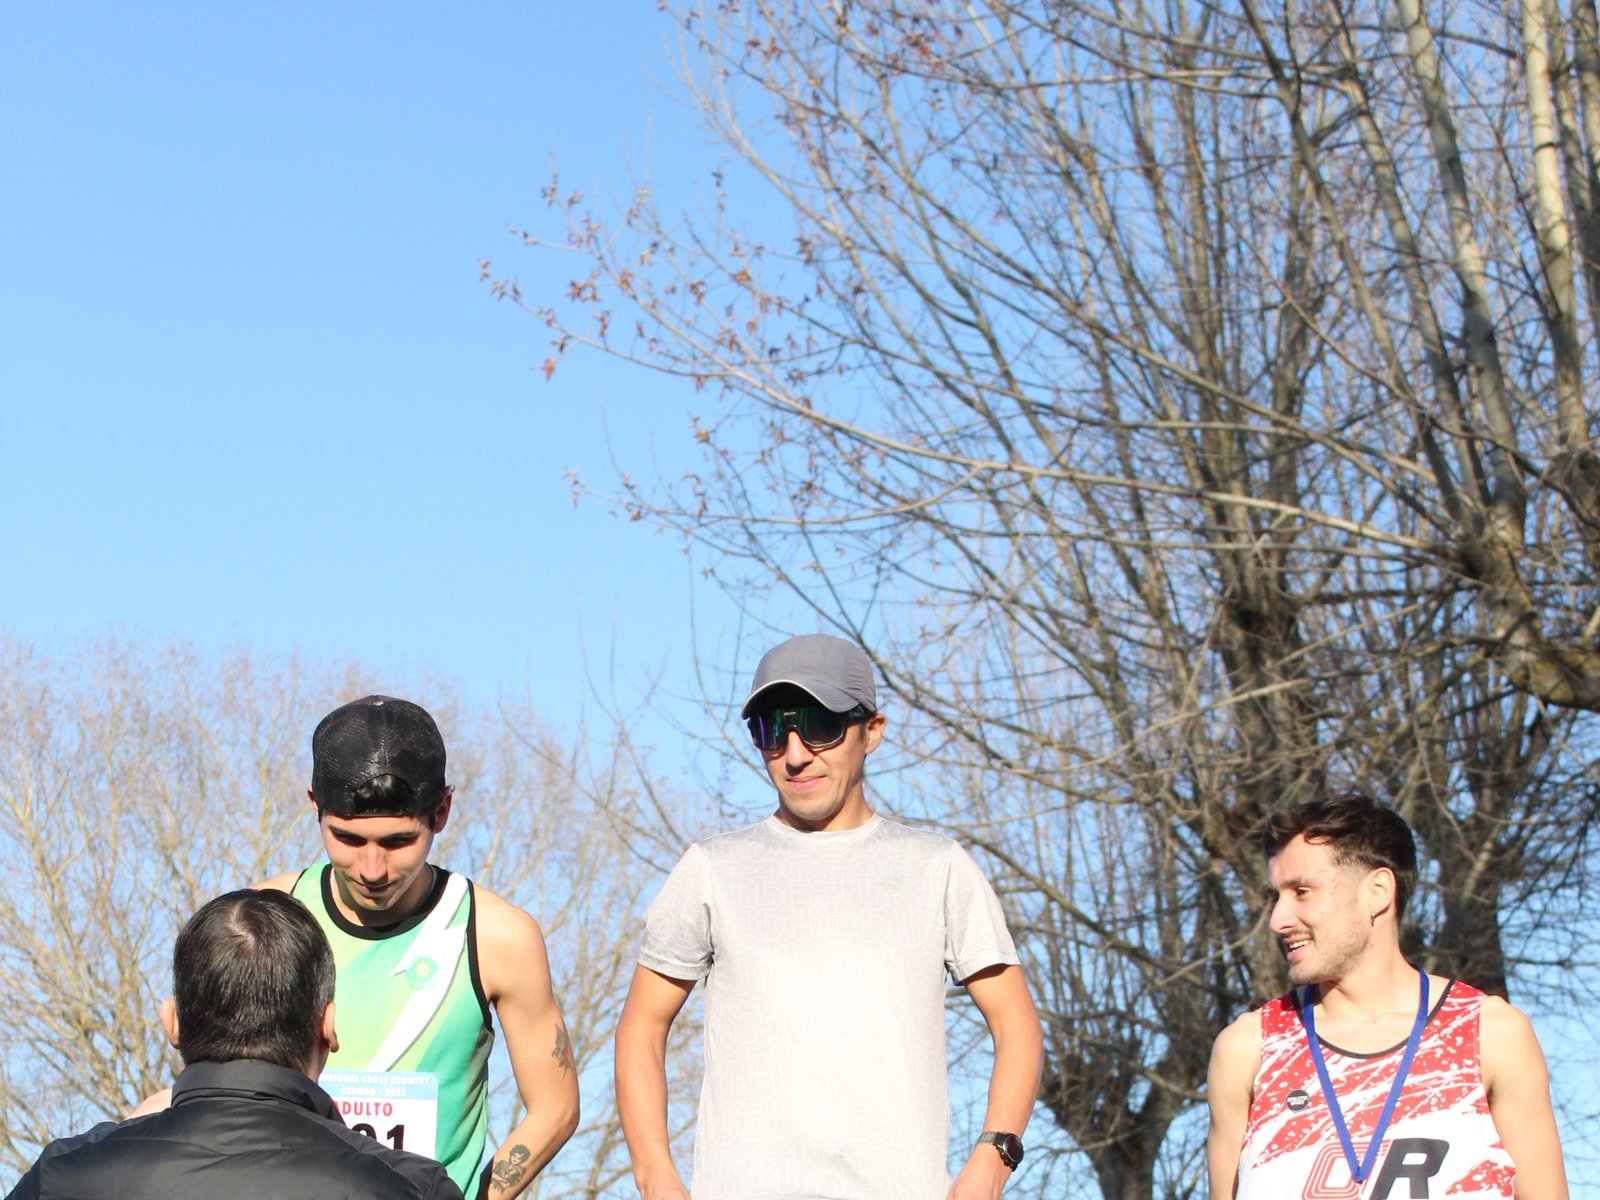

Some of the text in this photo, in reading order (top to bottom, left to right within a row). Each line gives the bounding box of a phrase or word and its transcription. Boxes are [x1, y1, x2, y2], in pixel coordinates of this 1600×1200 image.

[362, 1074, 389, 1085] CROSS
[391, 1075, 430, 1086] COUNTRY
[340, 1086, 376, 1096] OSORNO
